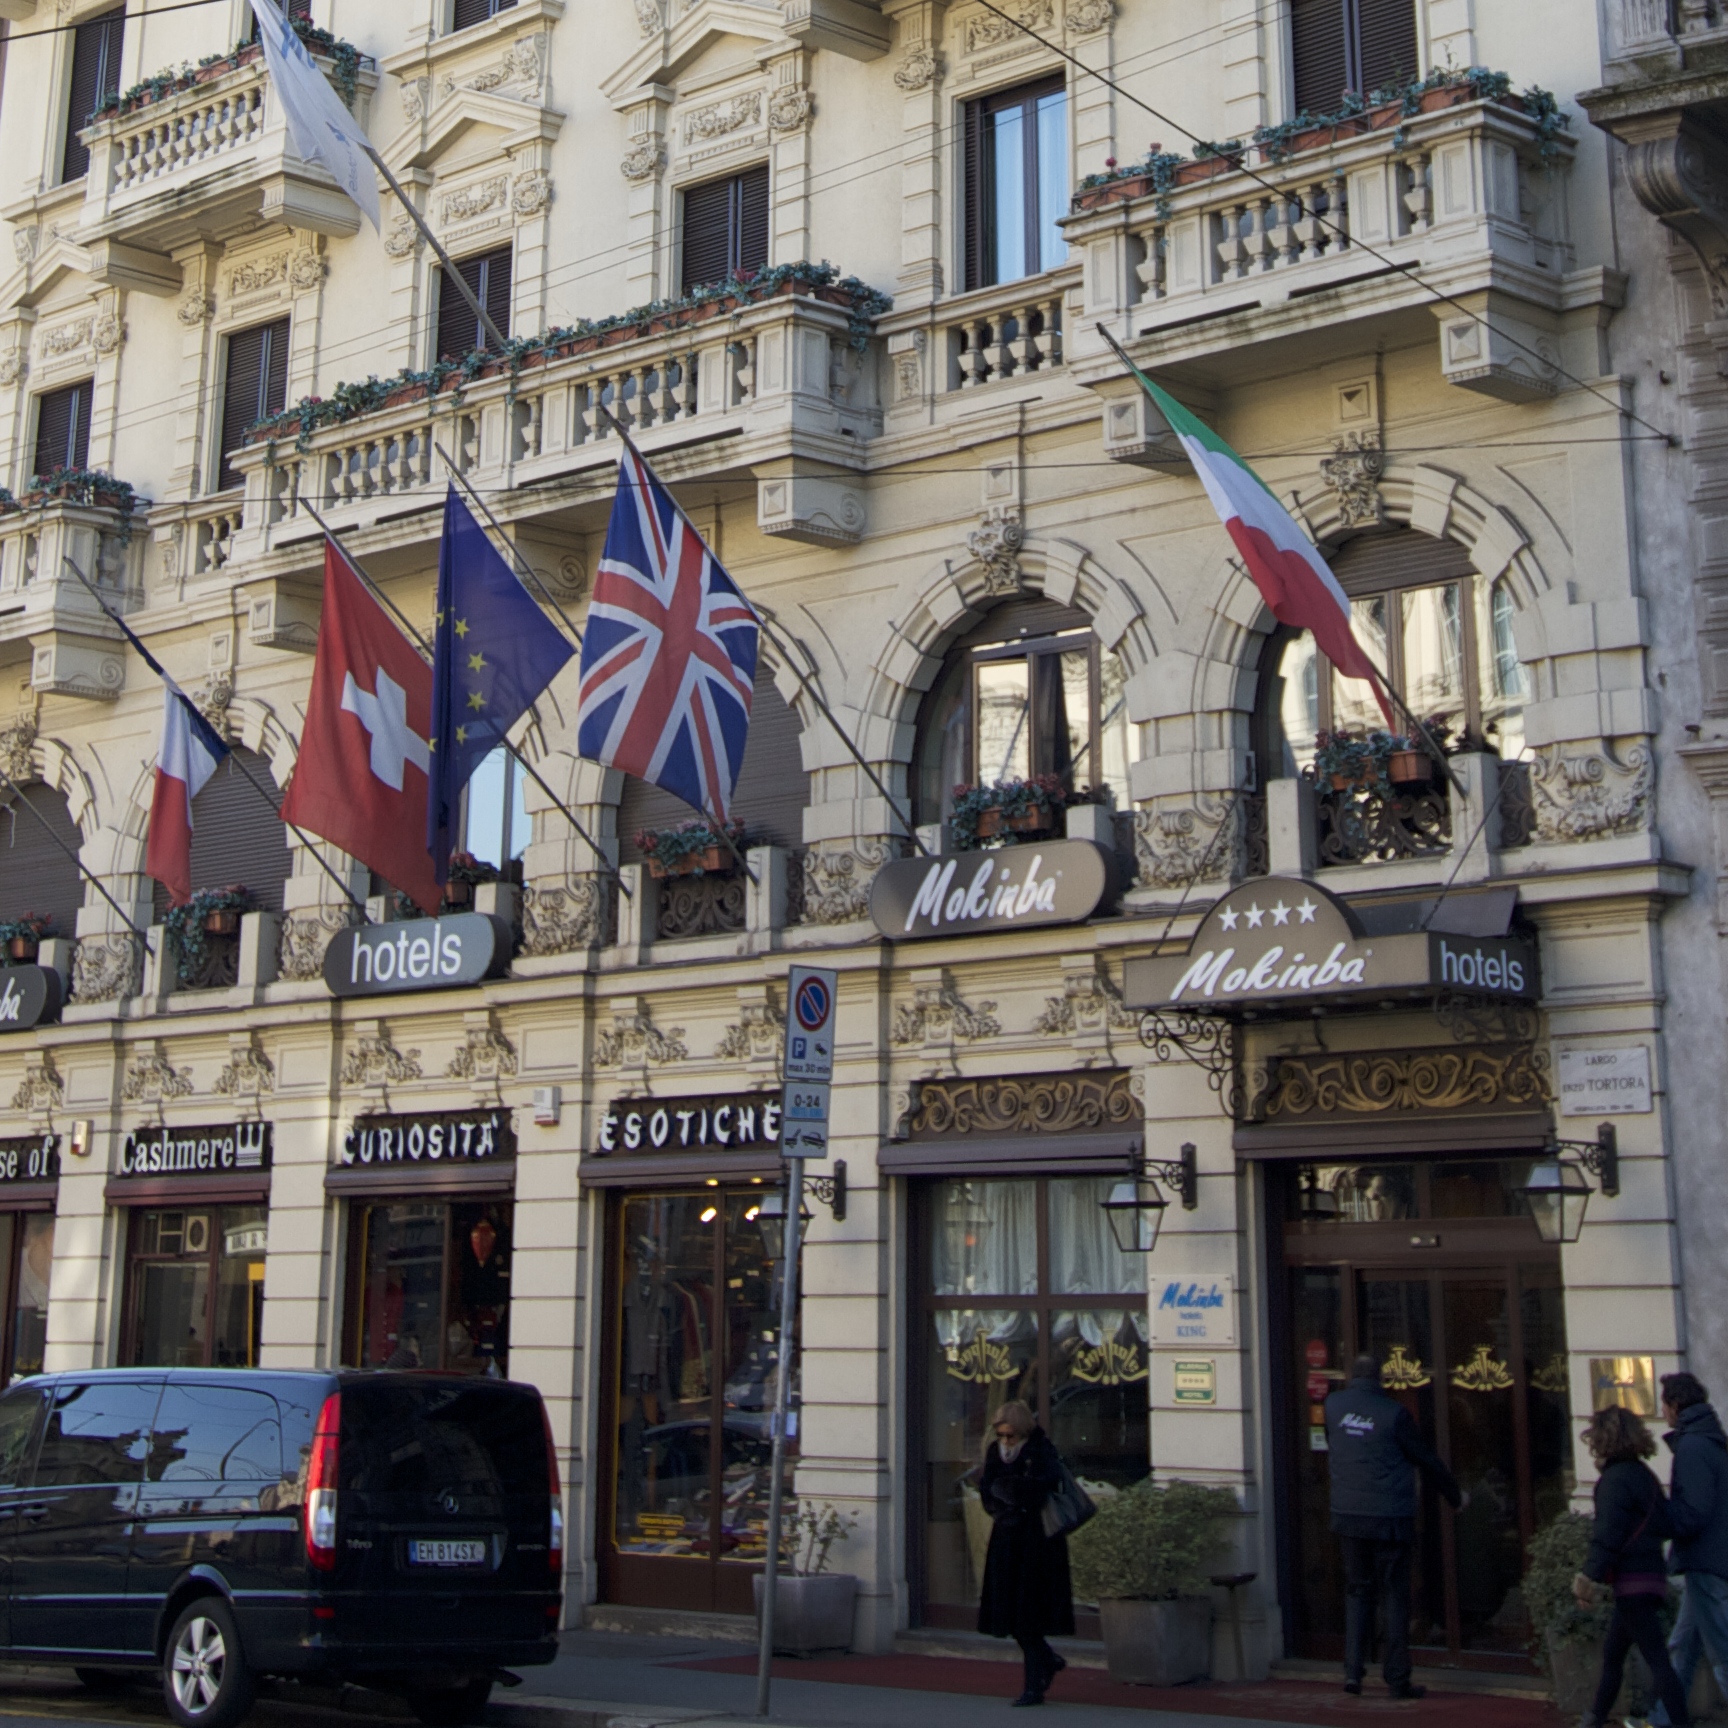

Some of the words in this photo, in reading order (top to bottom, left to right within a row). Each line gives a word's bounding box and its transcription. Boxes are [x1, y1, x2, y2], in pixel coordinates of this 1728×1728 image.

[903, 854, 1057, 932] Mokinba
[350, 922, 462, 984] hotels
[1170, 941, 1367, 1001] Mokinba
[1439, 939, 1525, 992] hotels
[1587, 1076, 1646, 1092] TORTORA
[121, 1129, 234, 1174] Cashmere
[600, 1100, 782, 1152] ESOTICHE
[29, 1134, 54, 1178] of
[418, 1543, 434, 1560] EH
[437, 1543, 477, 1561] 814SX
